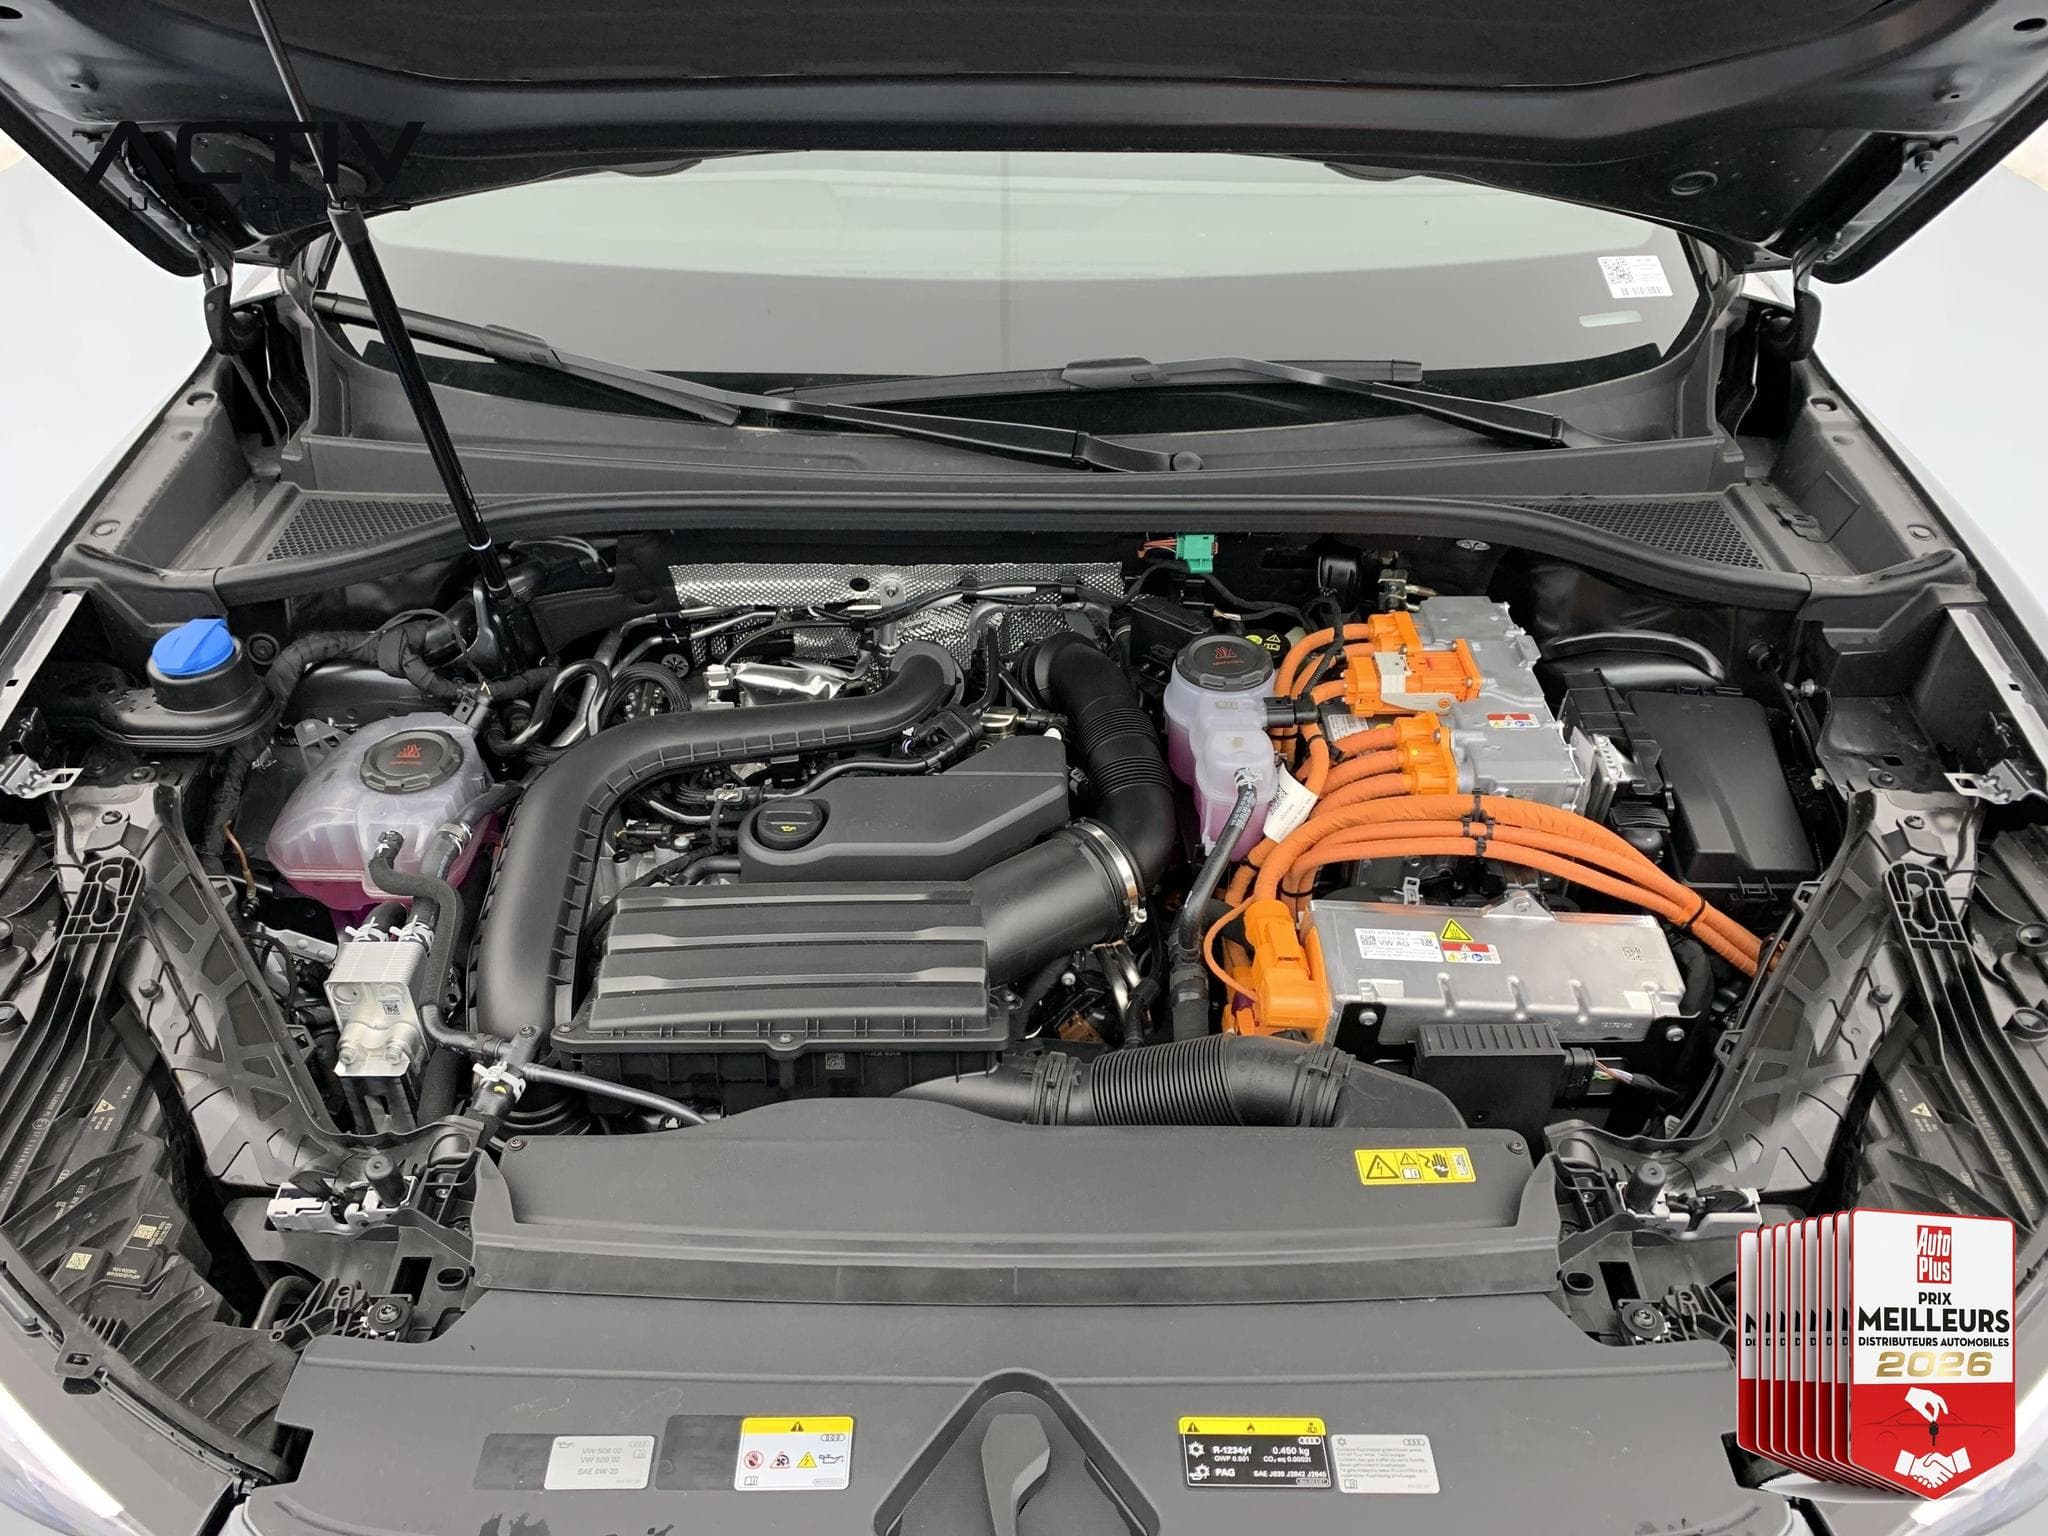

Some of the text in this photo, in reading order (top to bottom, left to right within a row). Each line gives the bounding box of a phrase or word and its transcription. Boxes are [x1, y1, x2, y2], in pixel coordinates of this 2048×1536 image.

[1213, 1445, 1252, 1456] R-1234yf
[1298, 1446, 1310, 1457] kg
[1215, 1468, 1236, 1477] PAG
